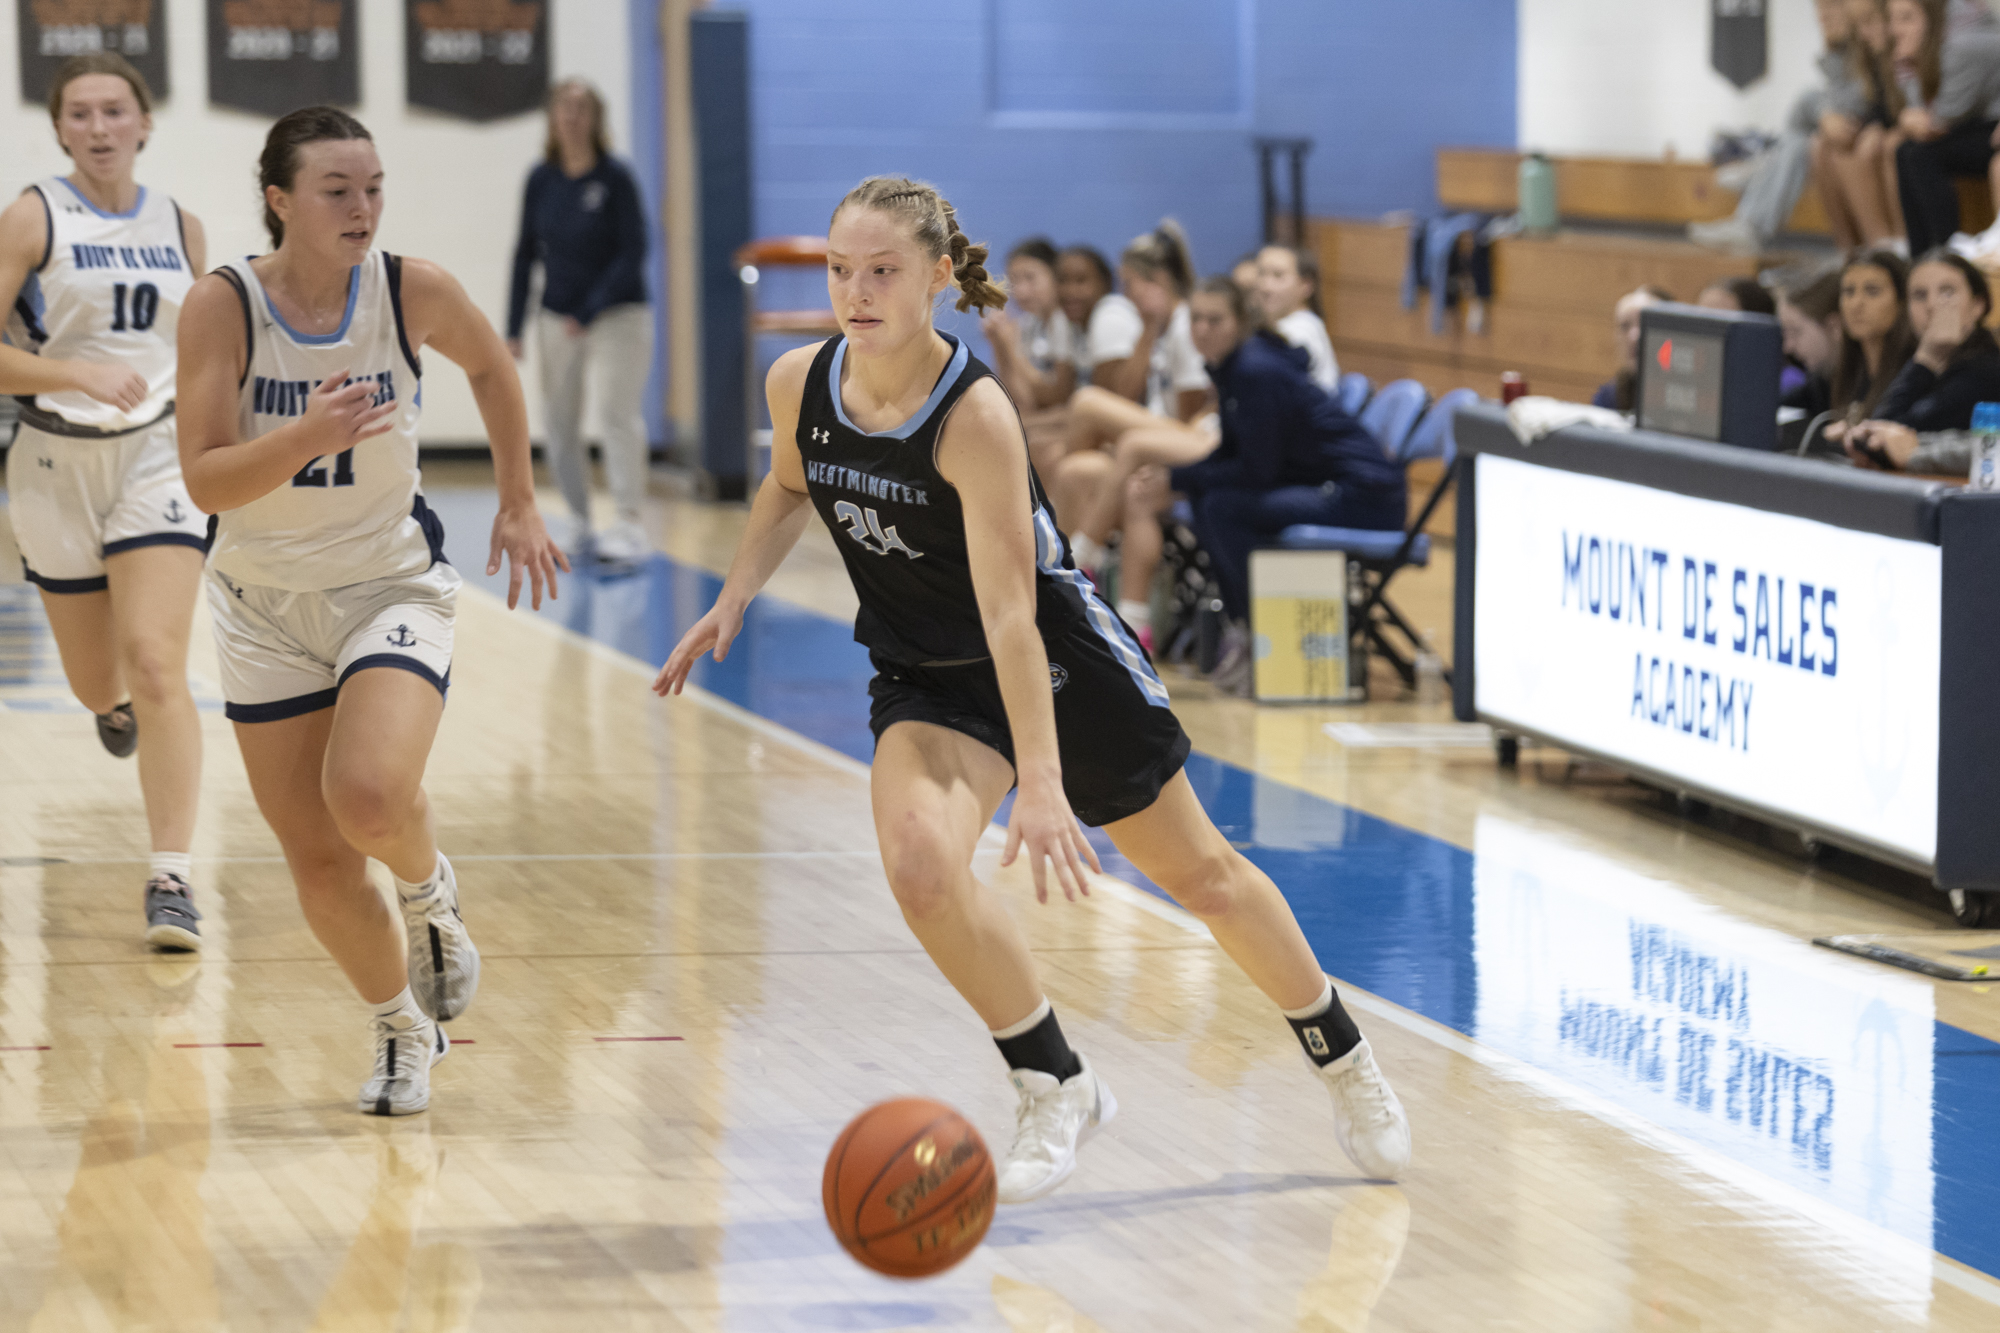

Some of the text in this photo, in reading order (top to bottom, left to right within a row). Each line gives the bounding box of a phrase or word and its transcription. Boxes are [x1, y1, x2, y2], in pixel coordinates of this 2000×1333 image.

[110, 281, 160, 332] 10
[807, 459, 930, 506] WESTMINSTER
[834, 499, 925, 560] 24
[1560, 529, 1838, 678] MOUNT DE SALES
[1630, 652, 1754, 752] ACADEMY
